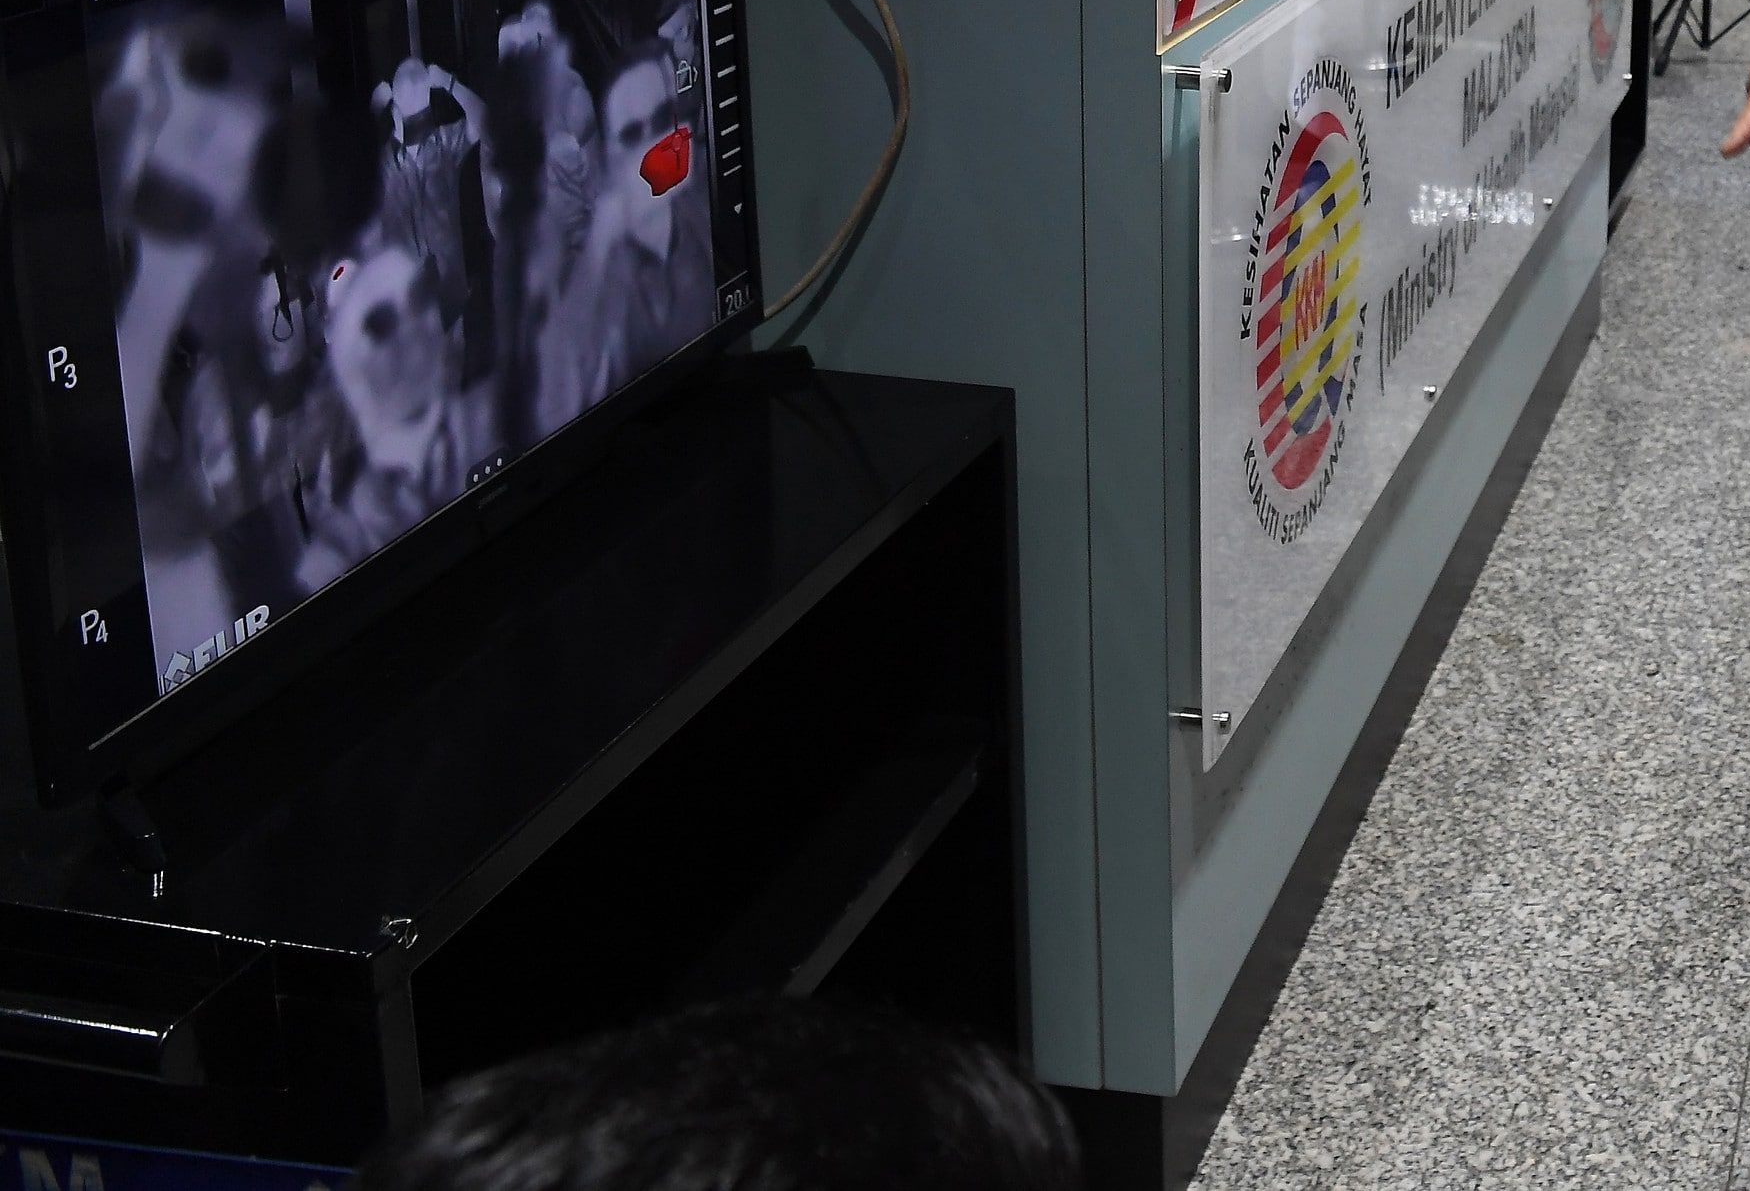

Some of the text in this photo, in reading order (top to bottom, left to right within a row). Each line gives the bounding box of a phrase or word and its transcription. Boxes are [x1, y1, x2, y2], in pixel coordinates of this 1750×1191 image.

[1463, 5, 1537, 148] MALAYSIA
[1240, 110, 1290, 340] KESIHATAN
[1293, 59, 1357, 119] SEPANJANG
[1243, 437, 1280, 540] KUALITI
[1281, 419, 1346, 544] SEPANJANG
[193, 605, 270, 672] FLIR
